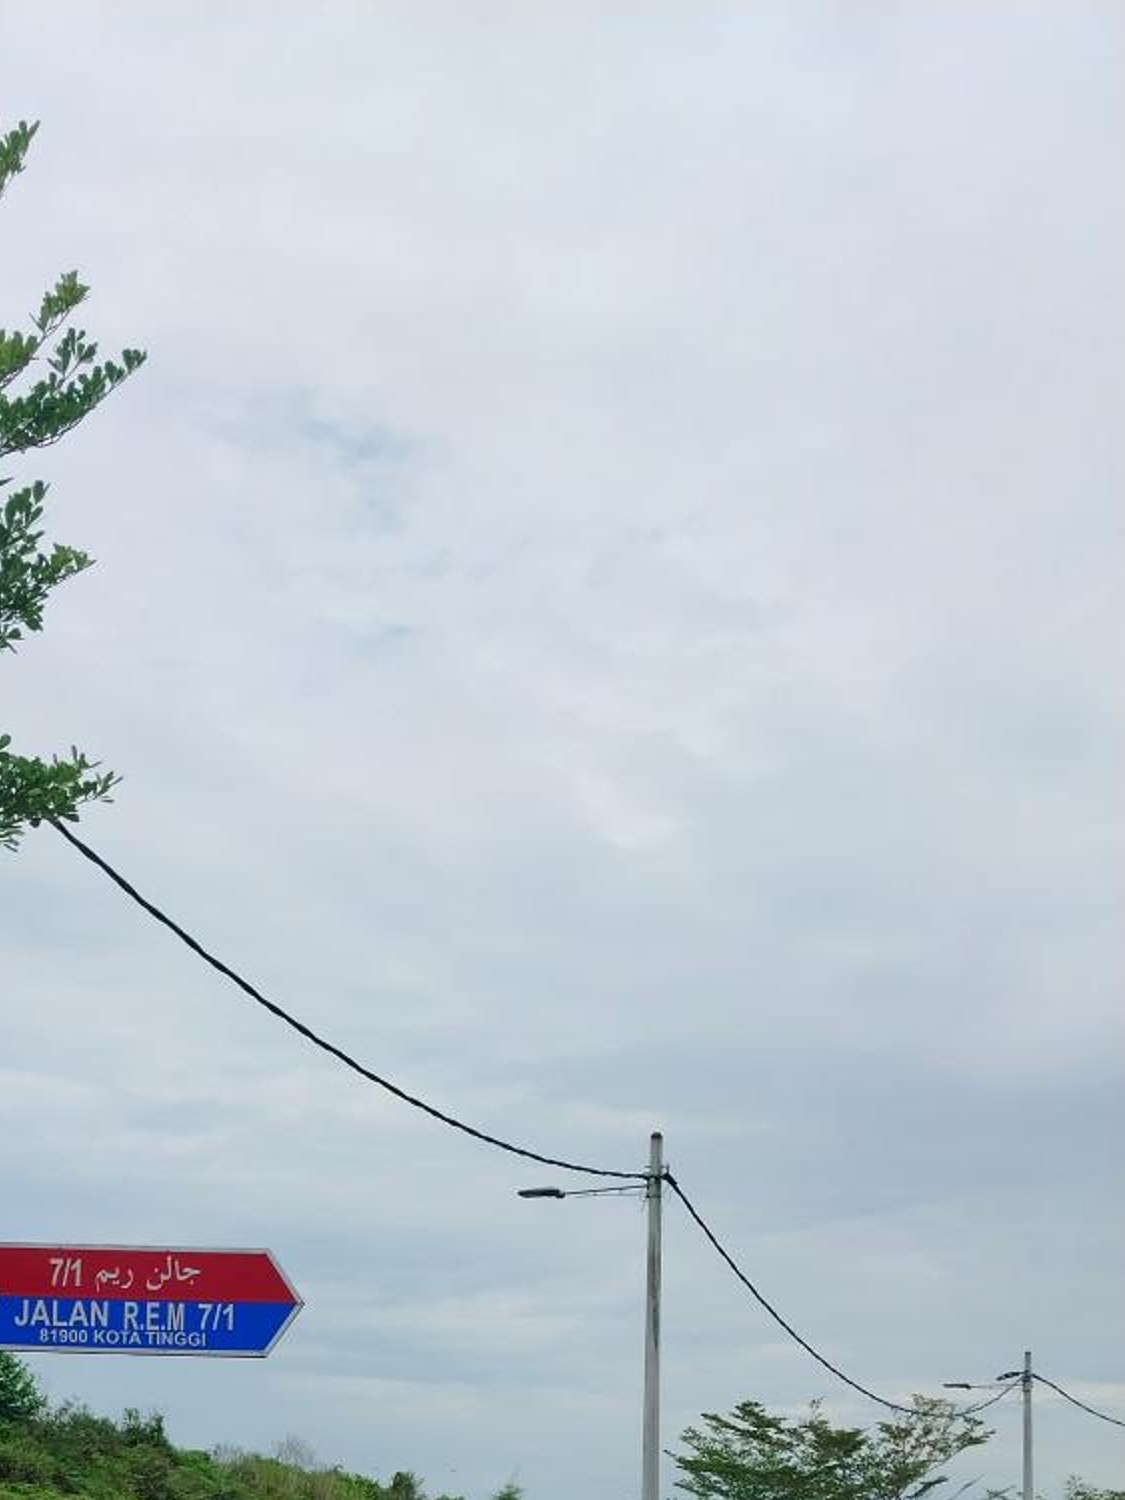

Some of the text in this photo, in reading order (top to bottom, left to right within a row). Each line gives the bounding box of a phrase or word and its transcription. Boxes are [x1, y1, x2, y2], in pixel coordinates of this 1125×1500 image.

[49, 1255, 202, 1292] جالن ريم 7/1
[14, 1299, 234, 1331] JALAN R.E.M 7/1
[39, 1328, 207, 1347] 81900 KOTA TINGGI
